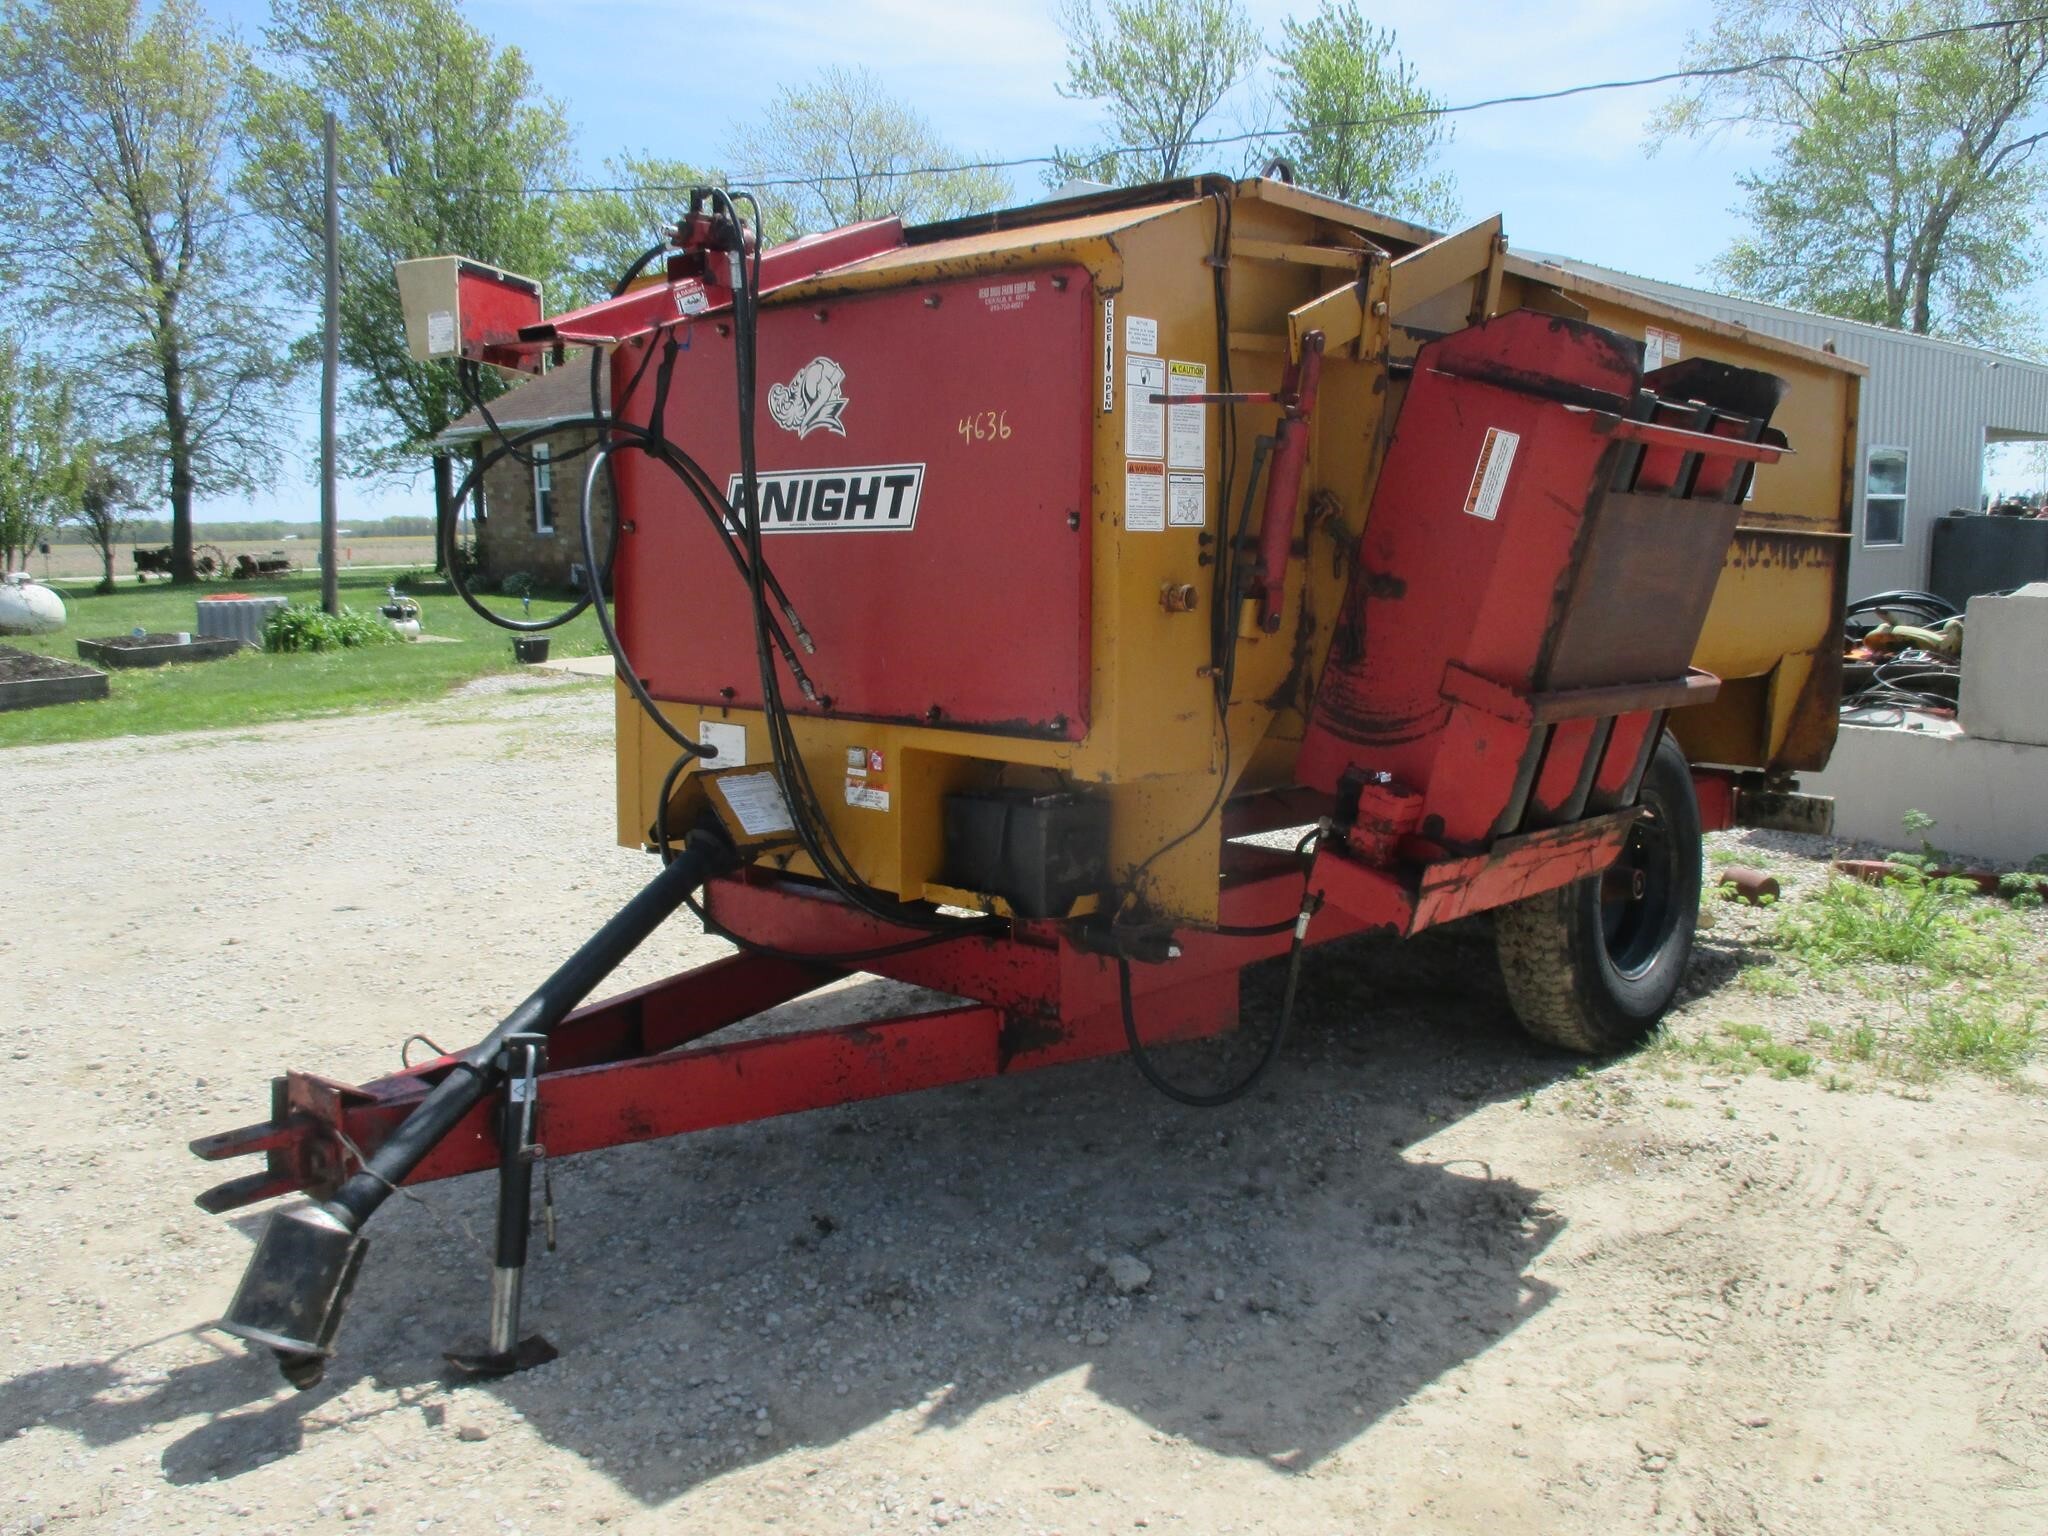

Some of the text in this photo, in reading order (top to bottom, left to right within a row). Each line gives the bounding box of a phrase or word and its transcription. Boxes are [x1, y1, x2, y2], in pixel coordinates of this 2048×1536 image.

[1179, 364, 1204, 376] CAUTION
[959, 410, 1011, 445] 4636
[1136, 464, 1162, 473] WARNING
